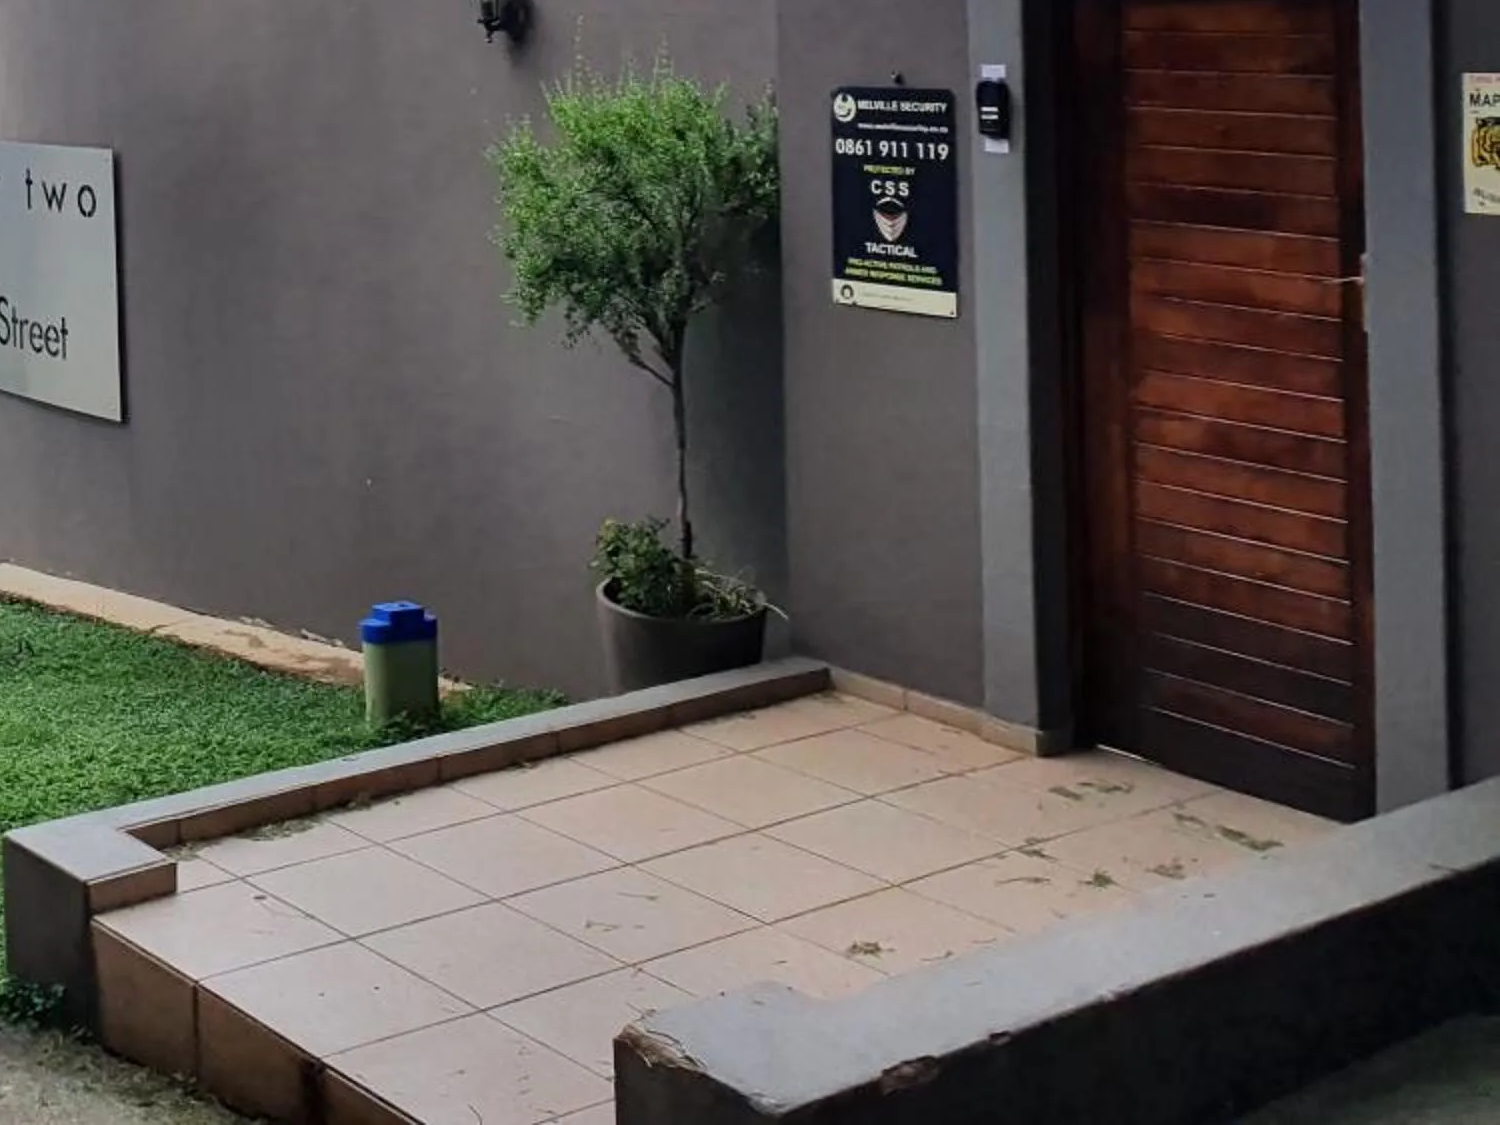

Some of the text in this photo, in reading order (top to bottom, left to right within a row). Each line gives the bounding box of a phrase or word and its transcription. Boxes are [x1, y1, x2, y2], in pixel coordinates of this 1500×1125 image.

[900, 102, 947, 113] SECURITY
[835, 138, 949, 160] 0861 911 119
[25, 168, 97, 218] two
[864, 242, 918, 258] TACTICAL
